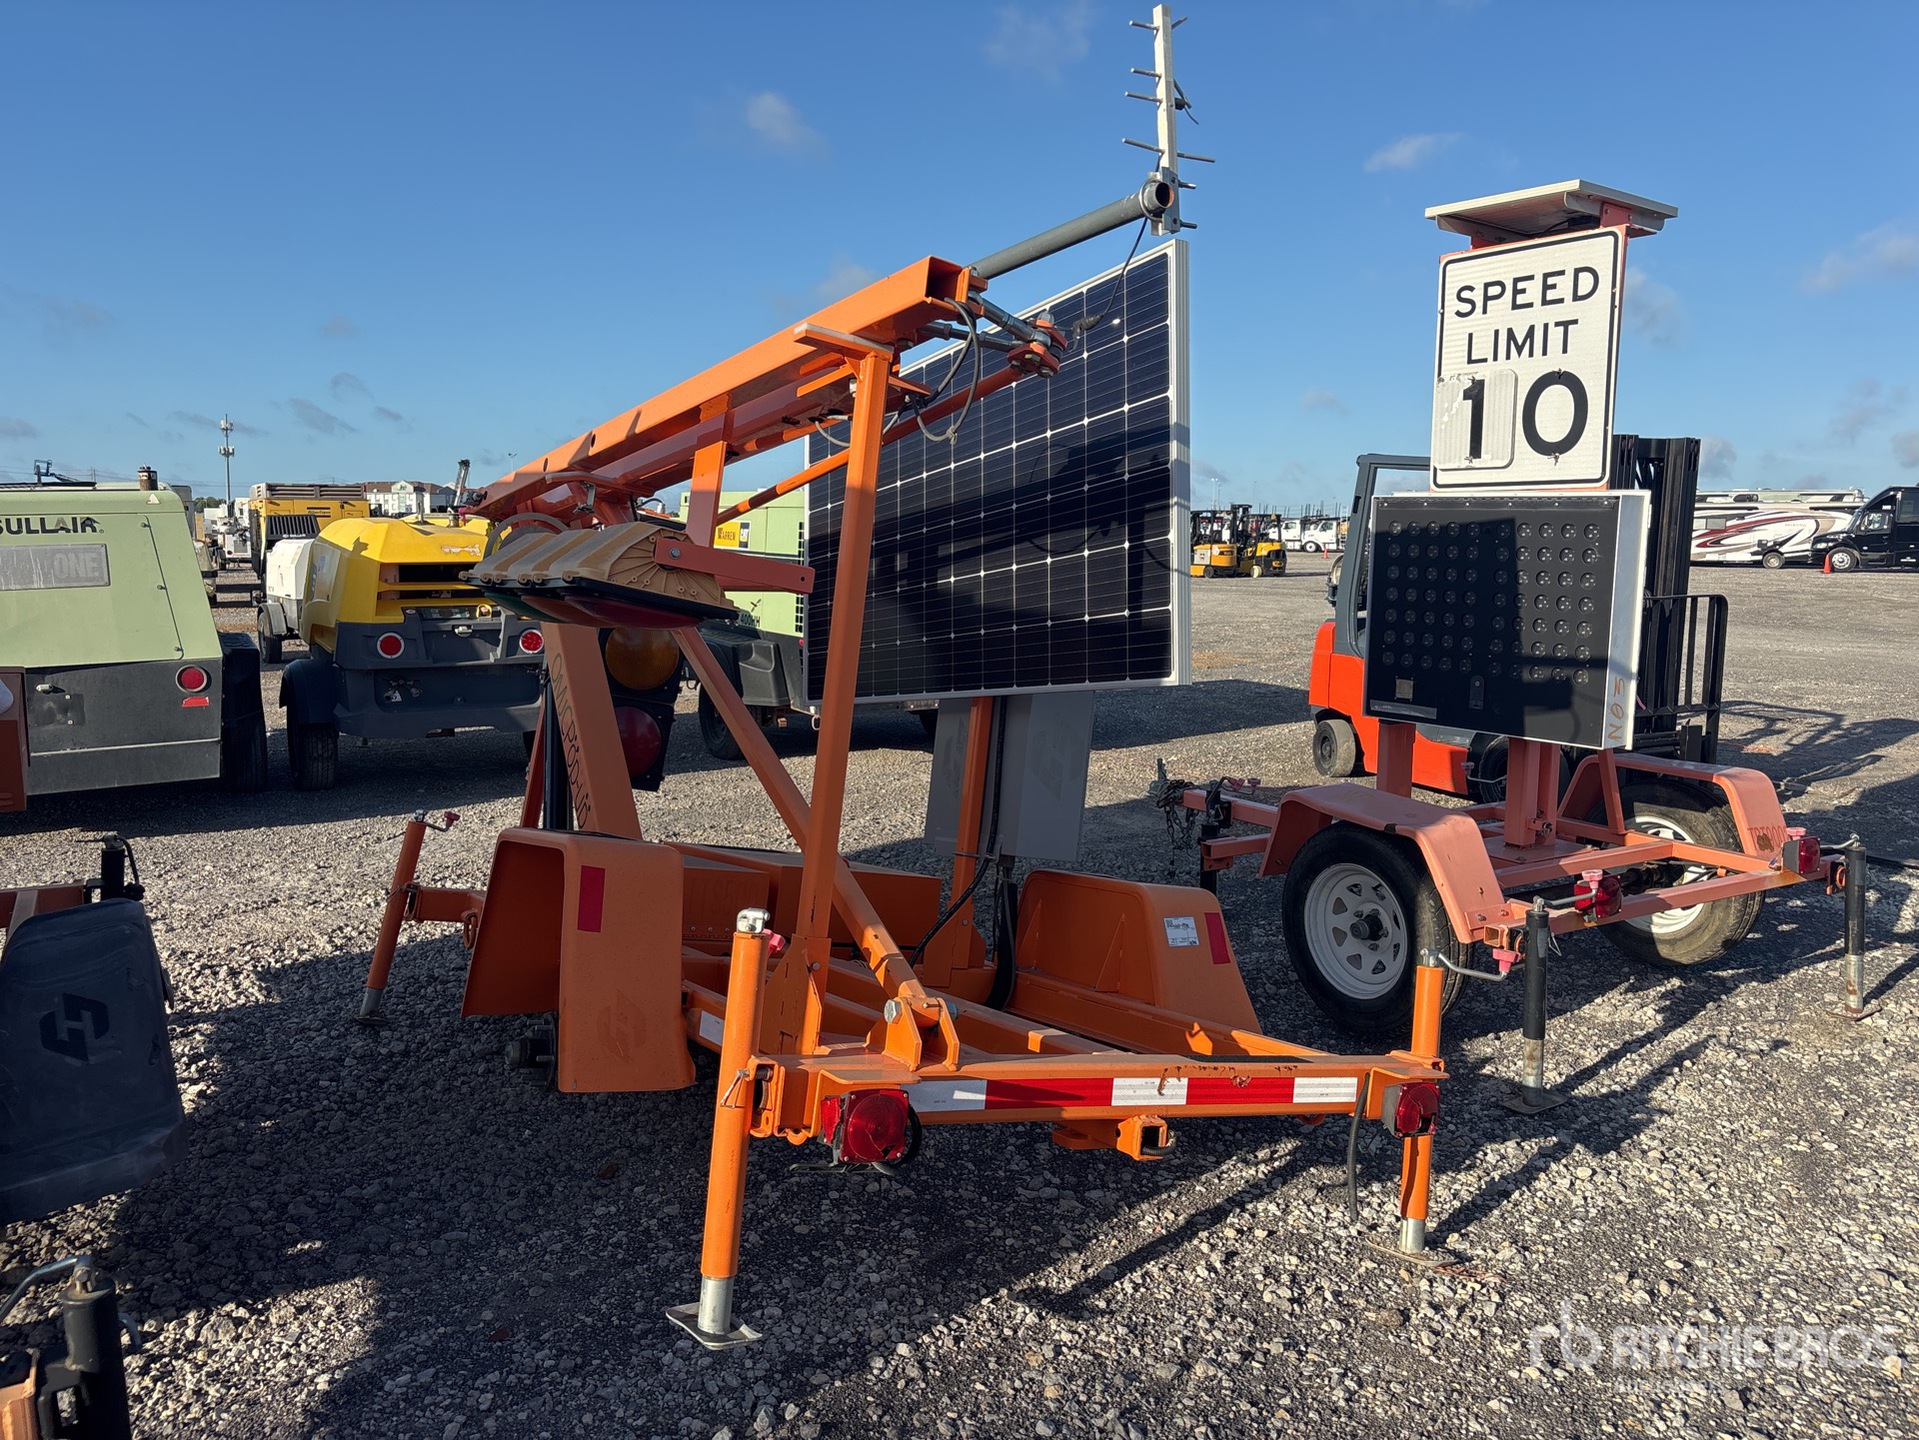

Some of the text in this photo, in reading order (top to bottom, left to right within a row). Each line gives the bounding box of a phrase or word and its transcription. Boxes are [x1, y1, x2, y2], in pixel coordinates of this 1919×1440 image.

[1454, 265, 1600, 318] SPEED
[1466, 318, 1579, 365] LIMIT
[1462, 370, 1589, 459] 10
[0, 516, 99, 535] ULLAIR
[54, 552, 100, 579] ONE
